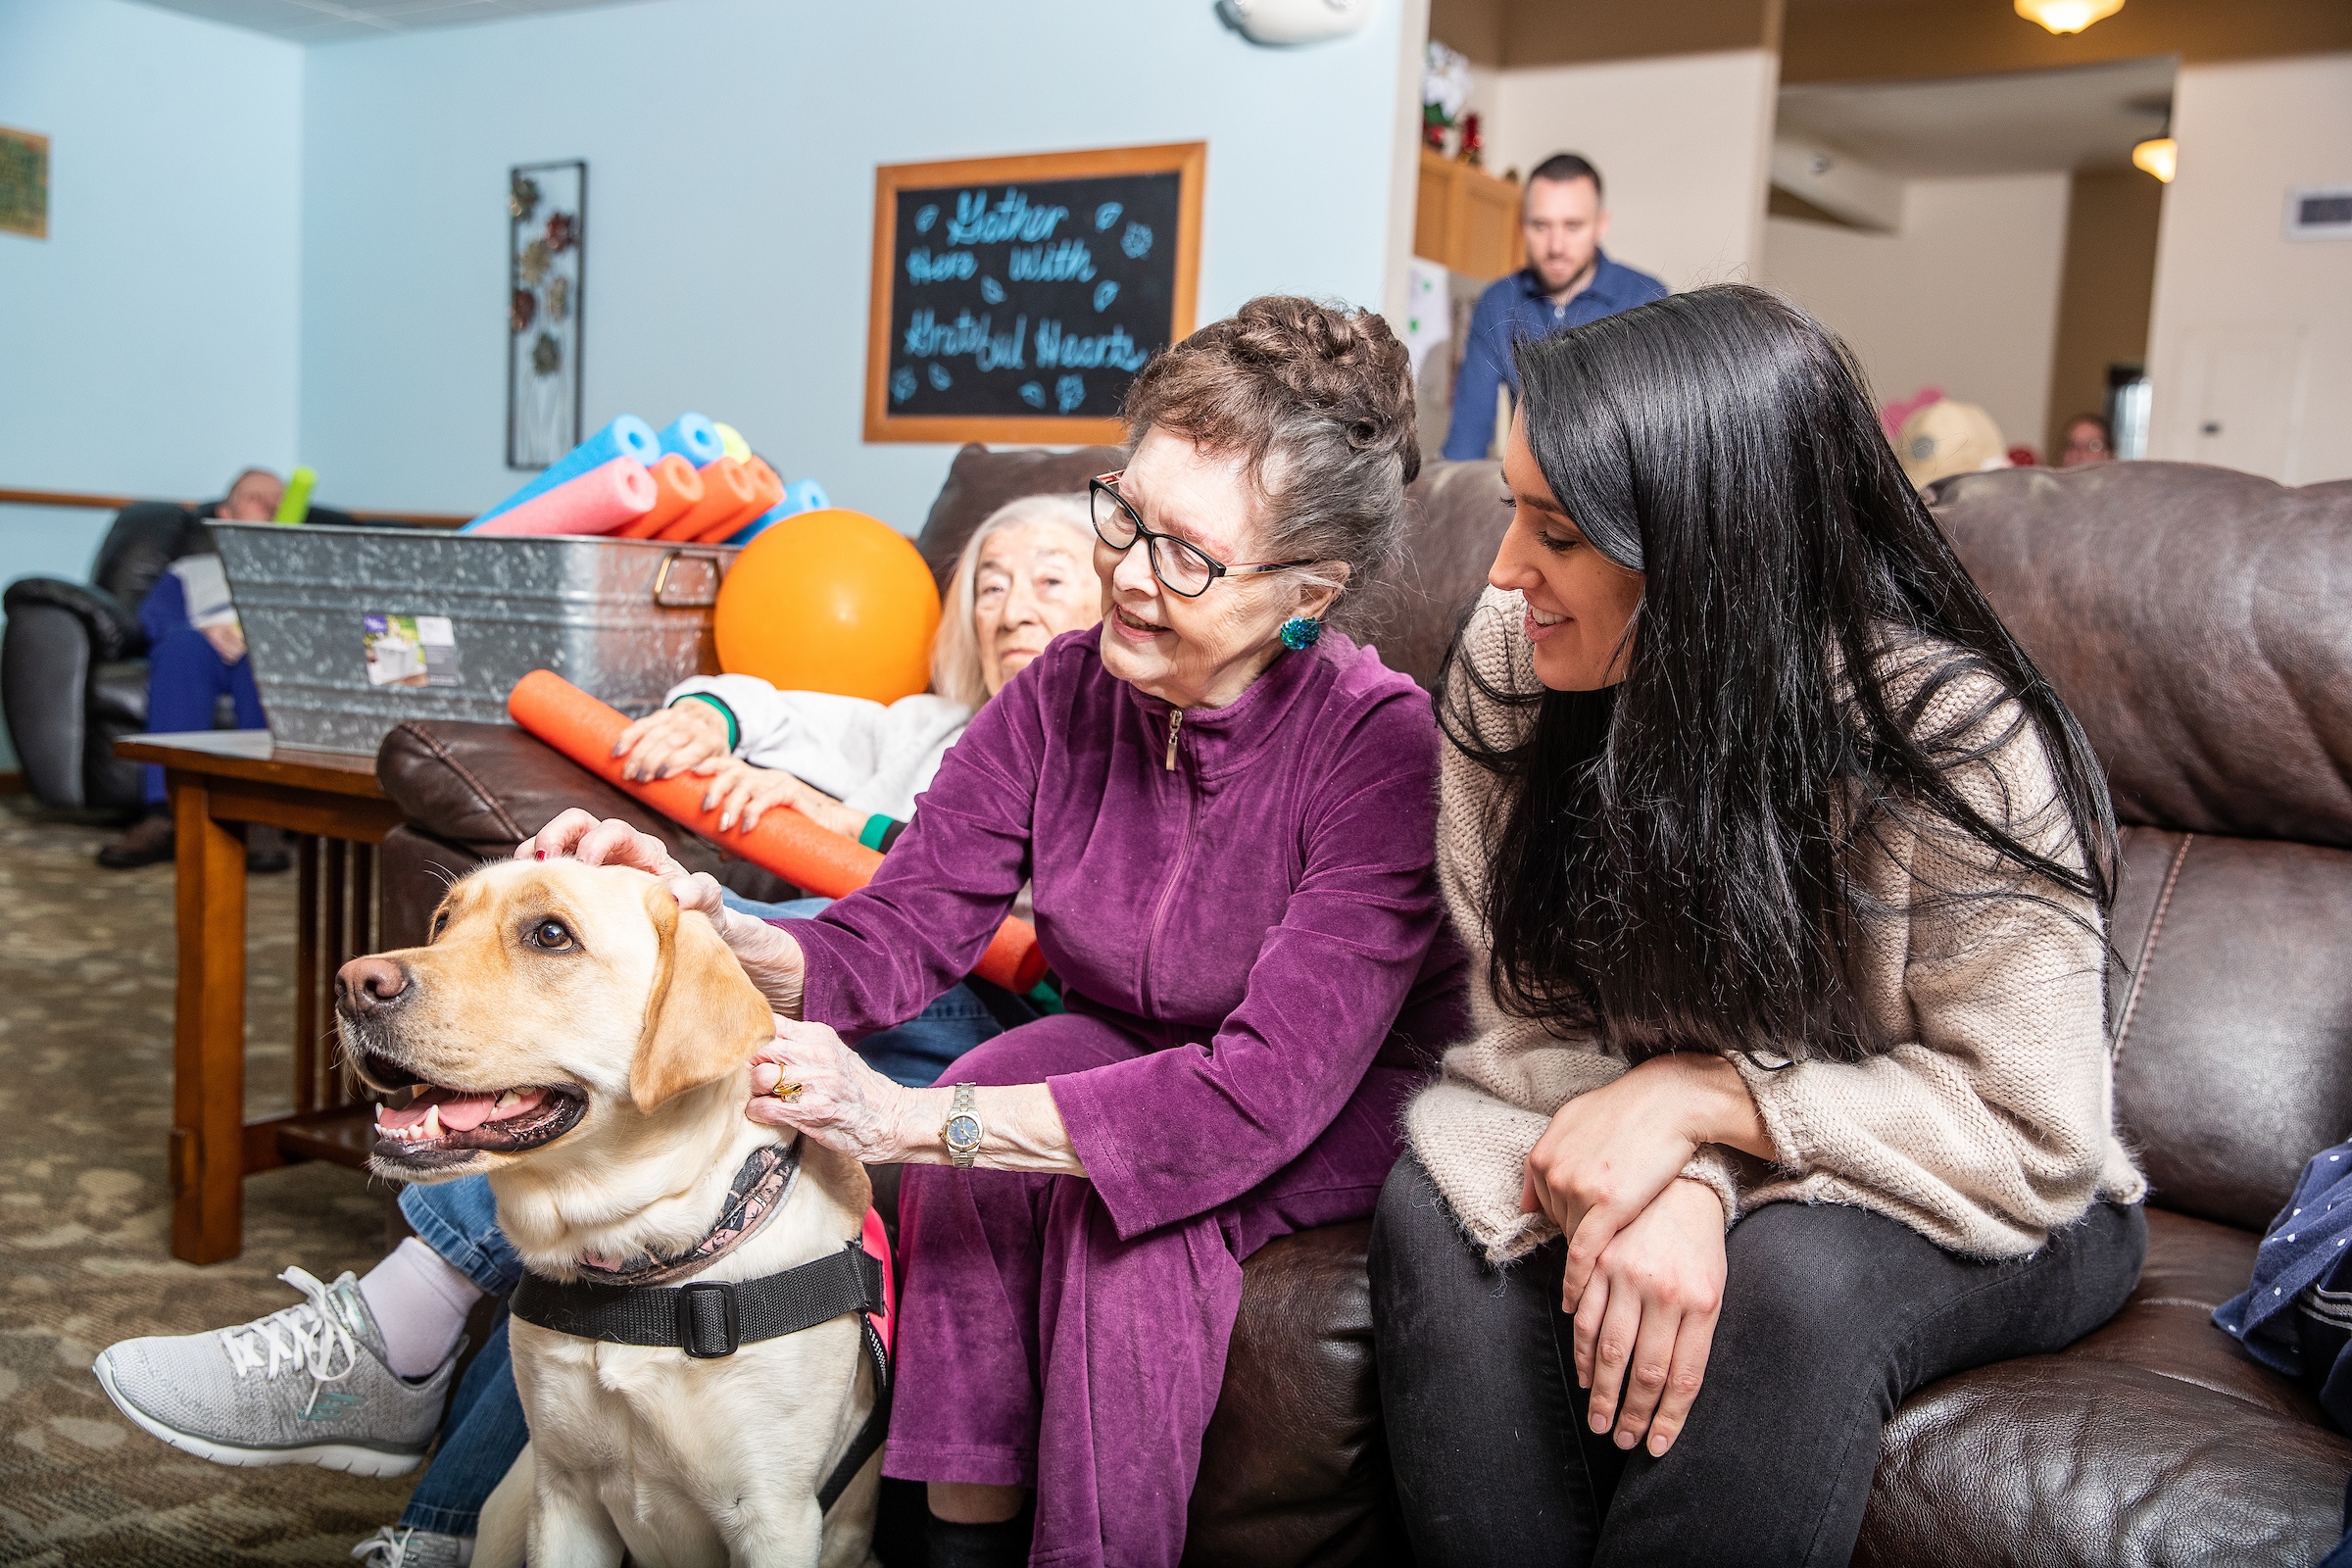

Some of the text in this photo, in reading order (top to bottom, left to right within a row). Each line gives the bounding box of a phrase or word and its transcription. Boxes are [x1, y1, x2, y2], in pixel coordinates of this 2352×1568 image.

[946, 185, 1069, 246] Gather
[1008, 237, 1097, 282] With
[1034, 317, 1149, 371] Hearts
